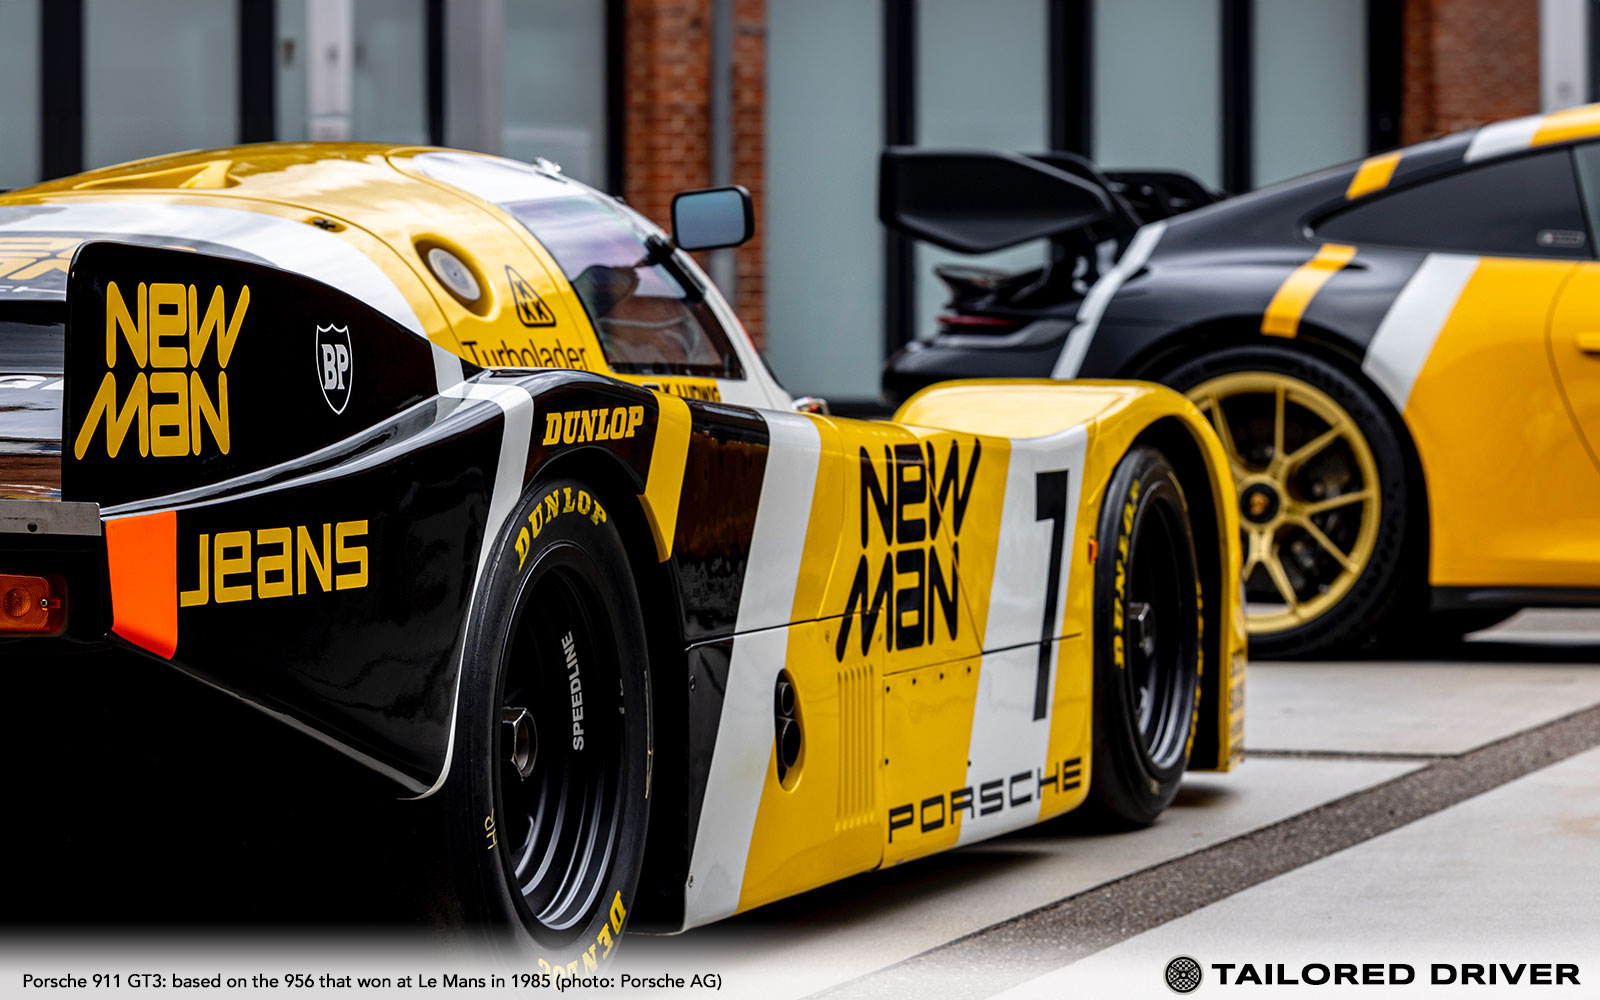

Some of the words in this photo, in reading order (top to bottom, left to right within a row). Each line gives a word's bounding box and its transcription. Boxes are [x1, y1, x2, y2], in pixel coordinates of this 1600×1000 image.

[321, 343, 349, 390] BP
[461, 339, 588, 371] Turbolader
[542, 405, 645, 446] DUNLOP
[514, 487, 607, 572] DUNLOP
[1033, 469, 1069, 722] 1
[561, 630, 585, 751] SPEEDLINE
[888, 756, 1082, 843] PORSCHE
